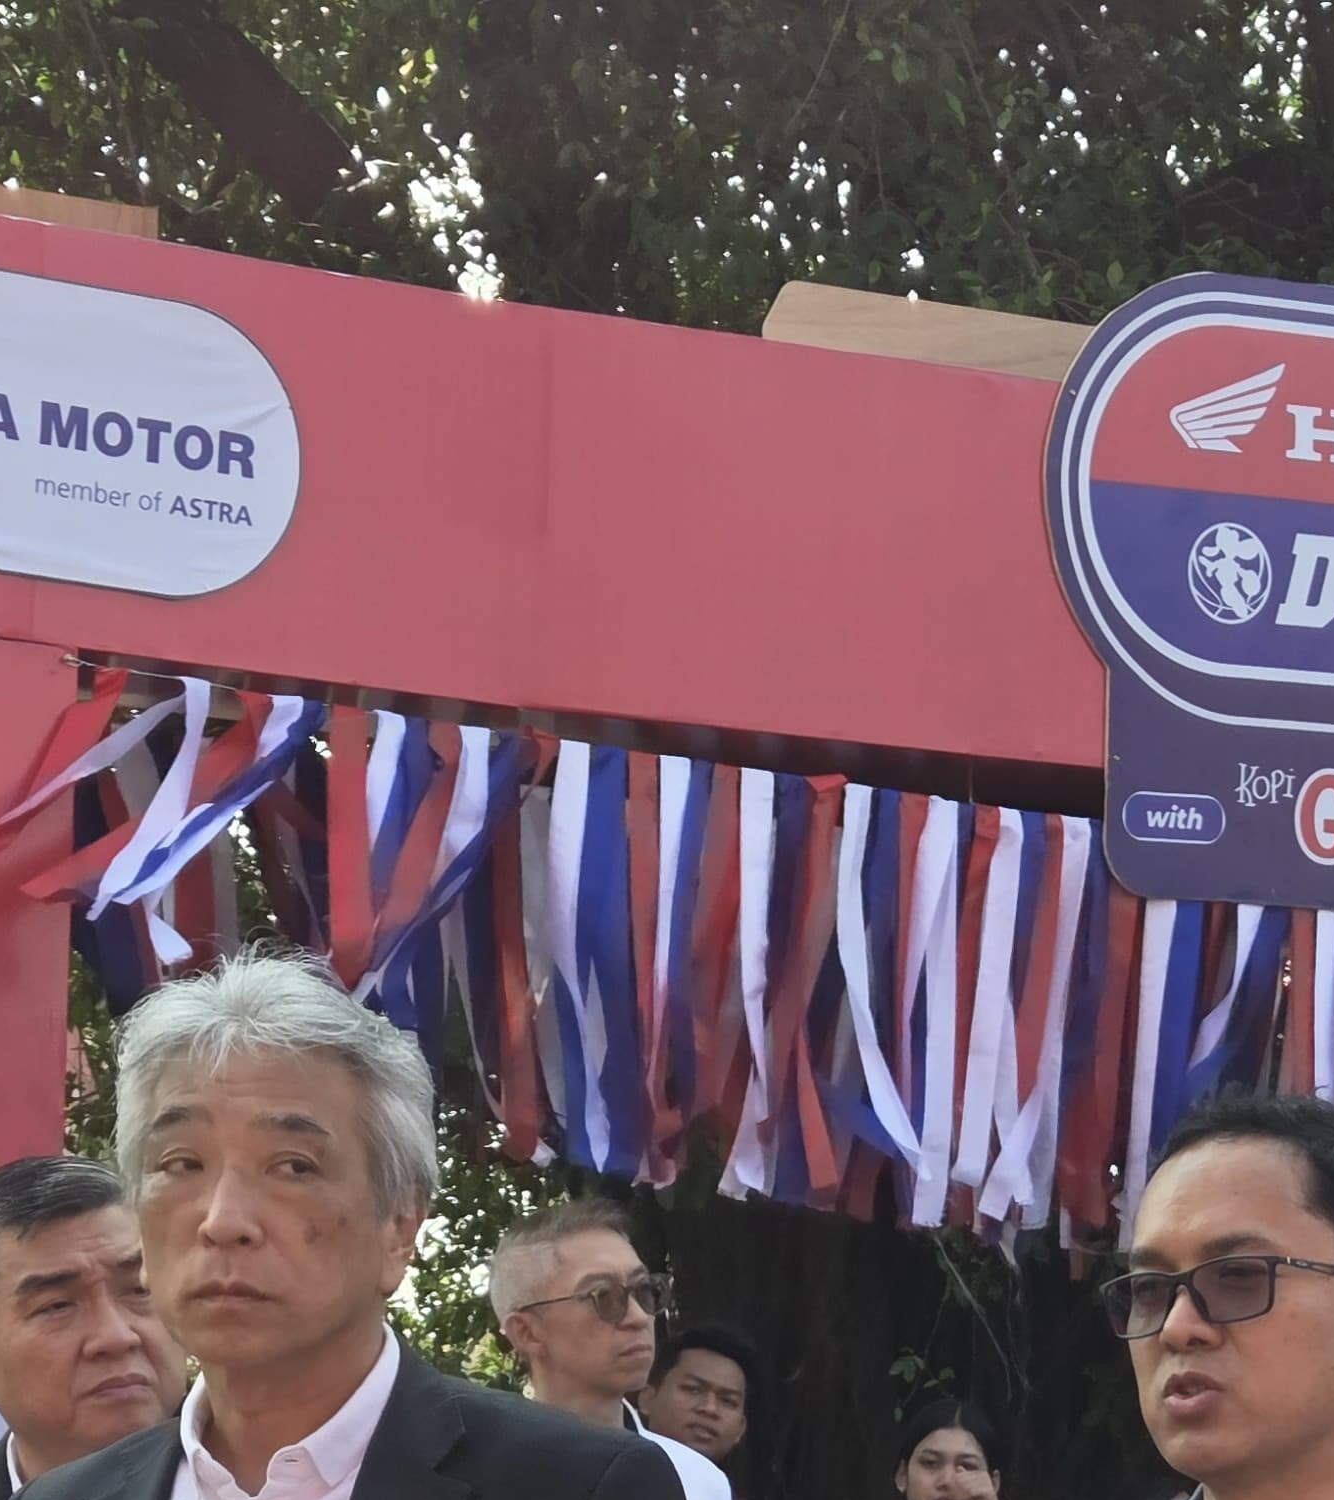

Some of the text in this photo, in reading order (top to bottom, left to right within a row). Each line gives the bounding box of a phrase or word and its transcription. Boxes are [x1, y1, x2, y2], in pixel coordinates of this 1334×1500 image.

[38, 400, 256, 479] MOTOR
[34, 477, 253, 527] member of ASTRA
[1146, 804, 1203, 831] with
